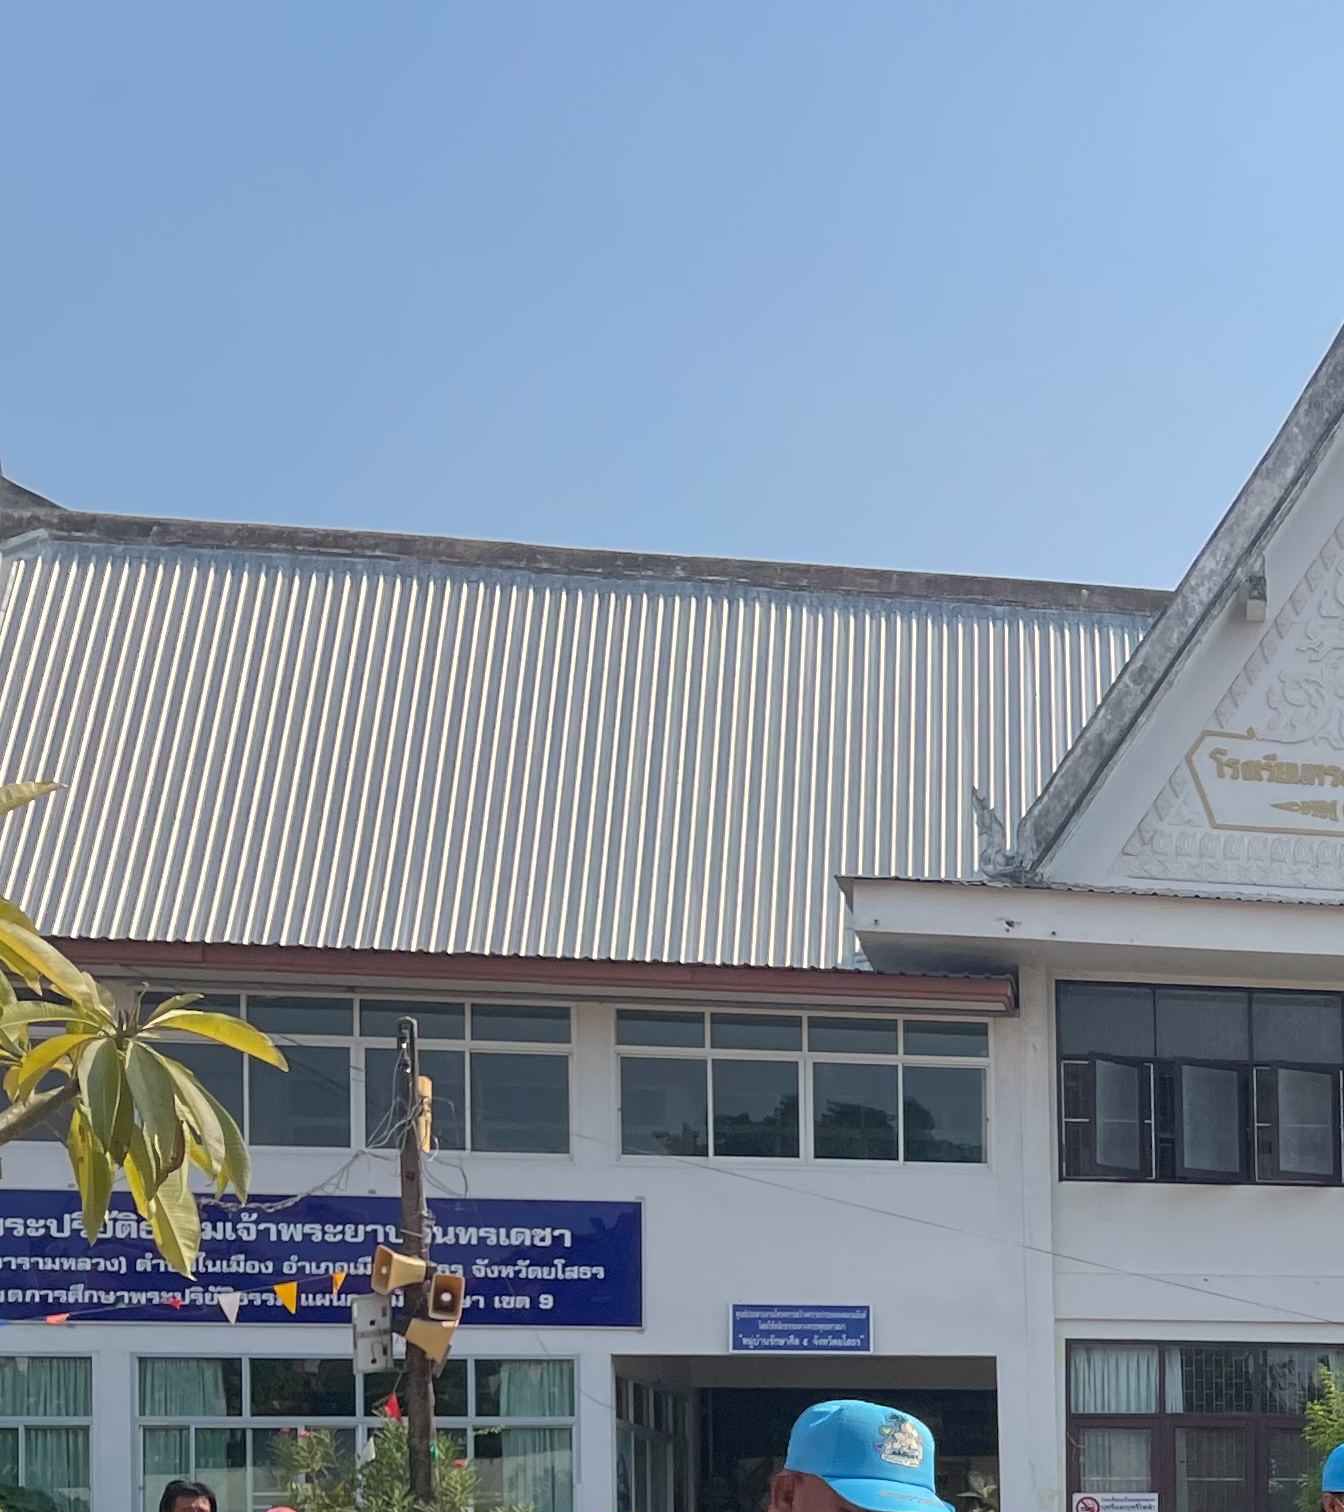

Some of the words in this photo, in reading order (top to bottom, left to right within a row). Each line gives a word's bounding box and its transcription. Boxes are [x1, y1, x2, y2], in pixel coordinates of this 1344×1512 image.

[471, 1259, 605, 1280] จังหวัดยโสธร
[494, 1294, 530, 1309] เขต
[538, 1294, 554, 1309] 9
